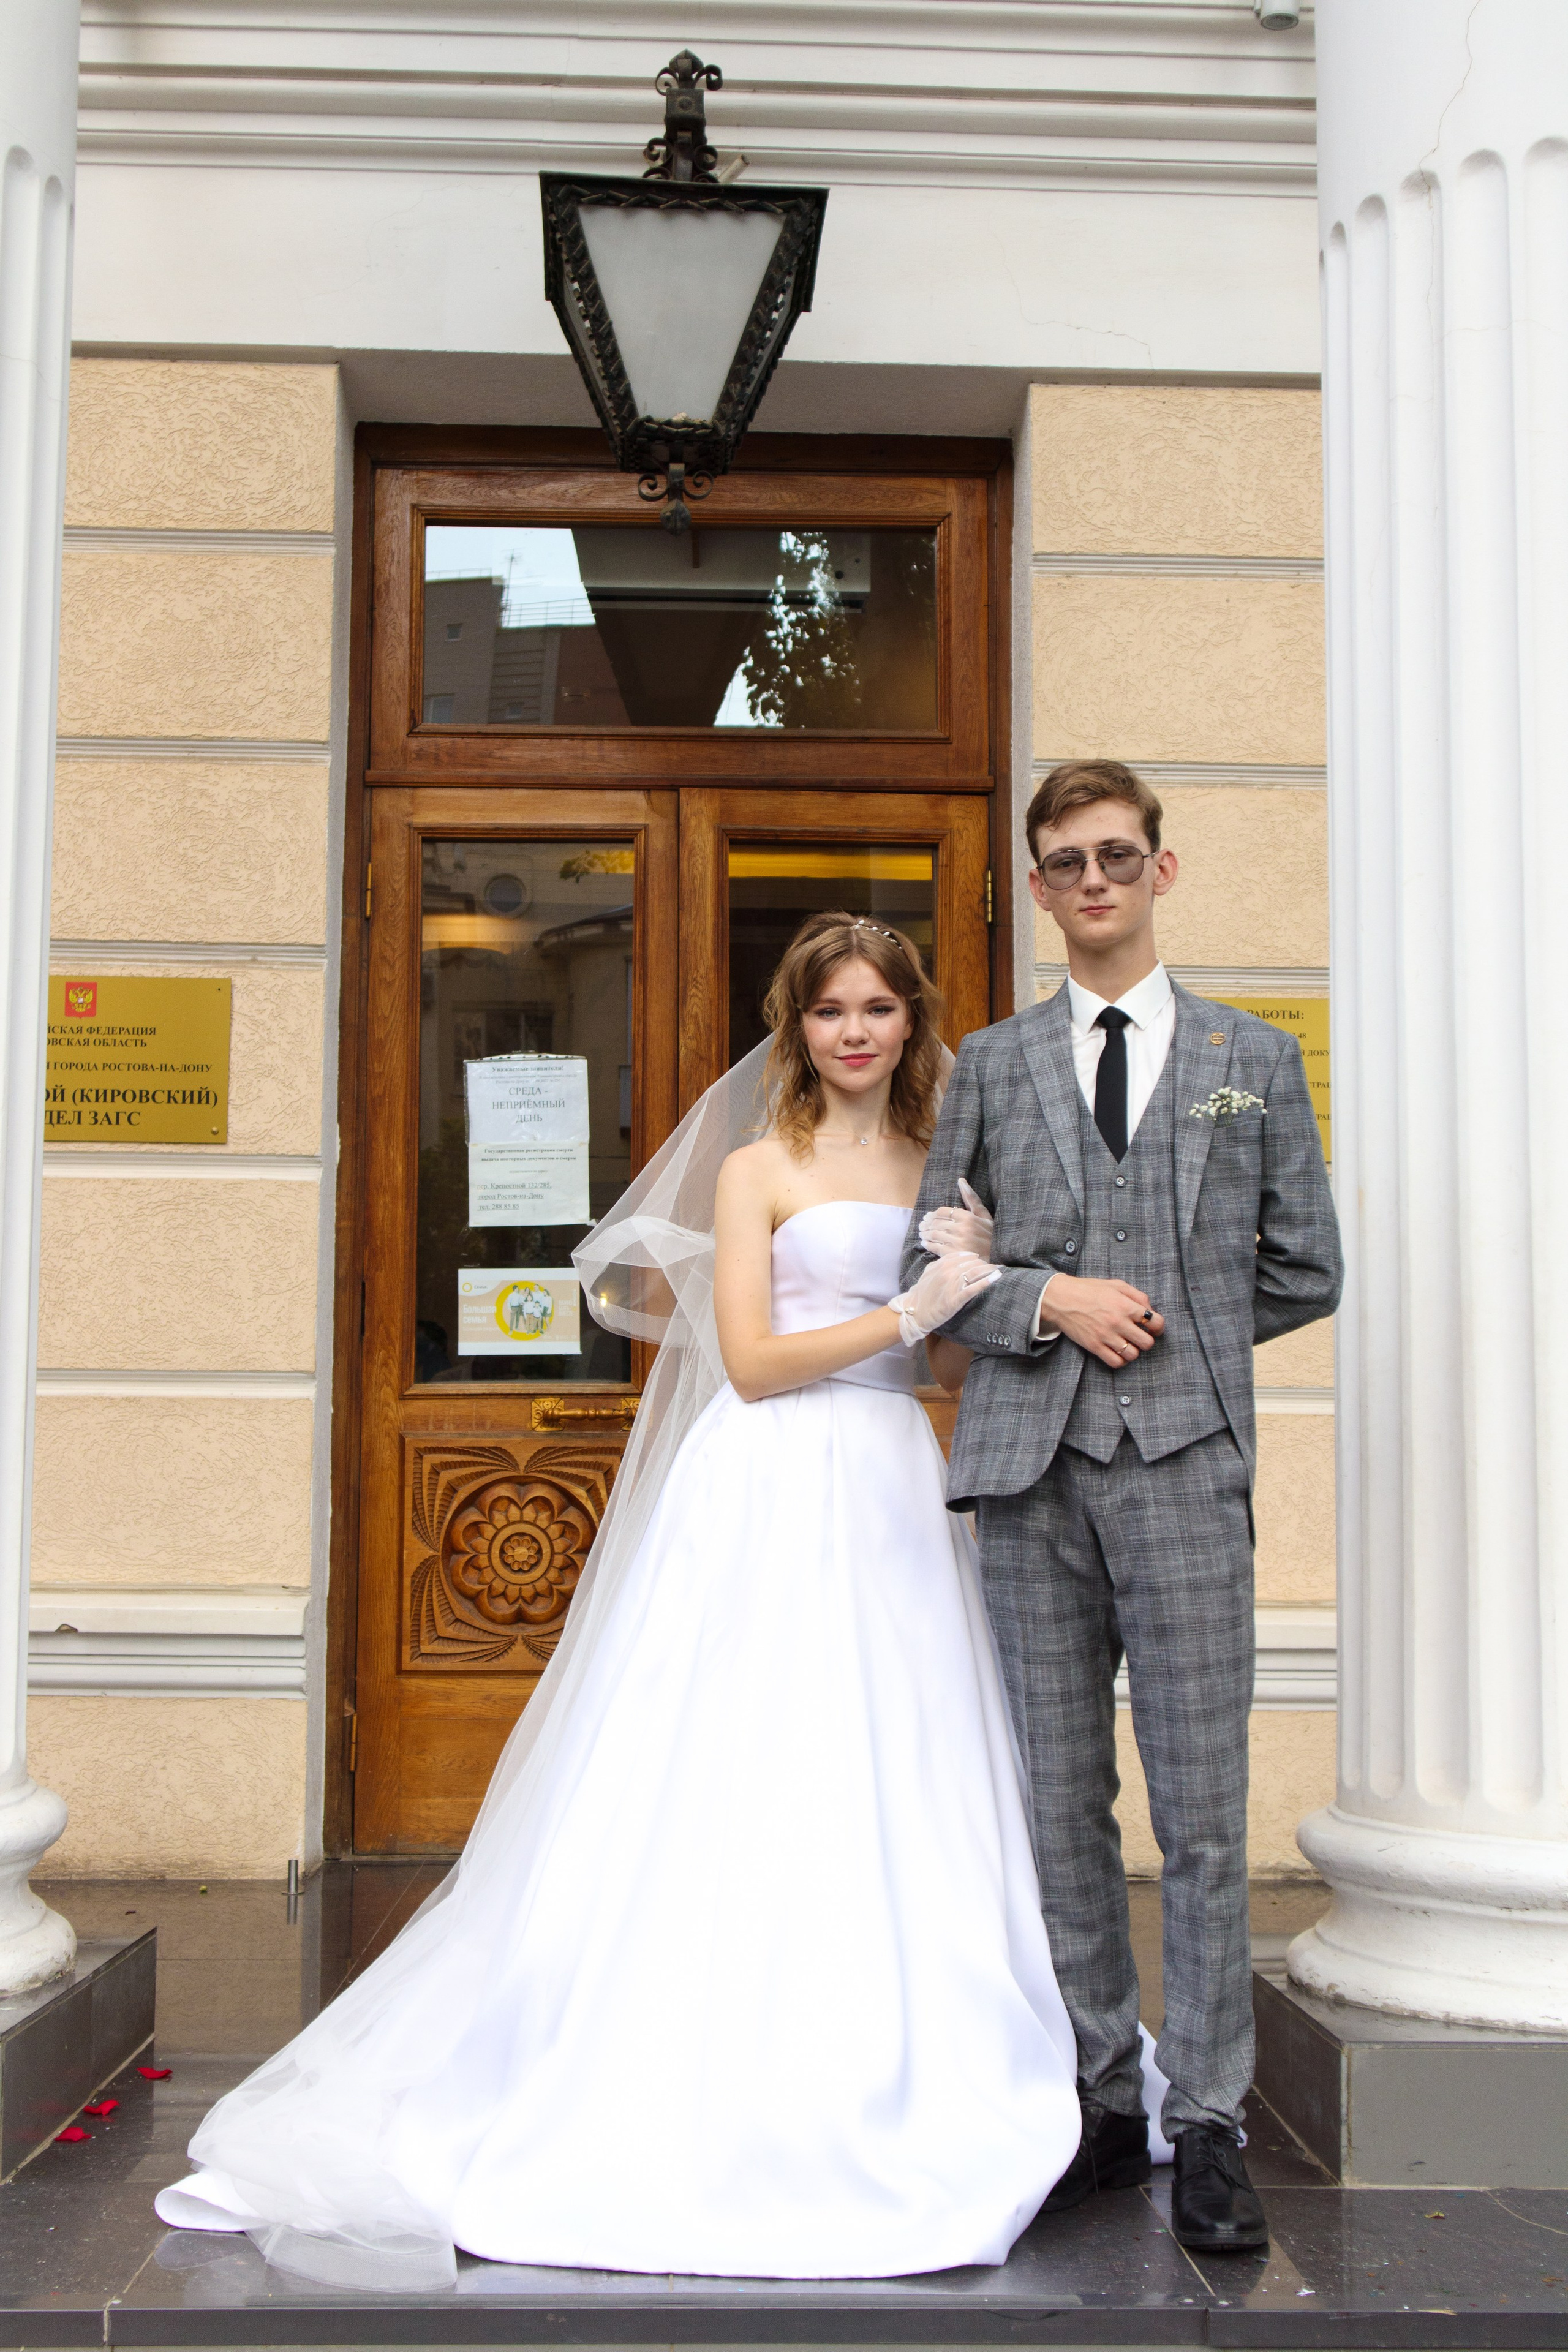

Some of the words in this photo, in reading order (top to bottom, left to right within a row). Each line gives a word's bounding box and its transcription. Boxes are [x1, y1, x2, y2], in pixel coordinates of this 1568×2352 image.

[86, 1025, 156, 1036] ФЕДЕРАЦИЯ
[93, 1038, 147, 1047] ОБЛАСТЬ
[53, 1061, 99, 1071] ГОРОДА
[102, 1062, 213, 1074] РОСТОВА-НА-ДОНУ
[508, 1087, 542, 1096] СРЕДА
[72, 1086, 218, 1109] (КИРОВСКИЙ)
[492, 1098, 565, 1109] НЕПРИЁМНЫЙ
[88, 1110, 141, 1126] ЗАГС
[516, 1114, 543, 1123] ДЕНЬ
[463, 1304, 497, 1314] Большая
